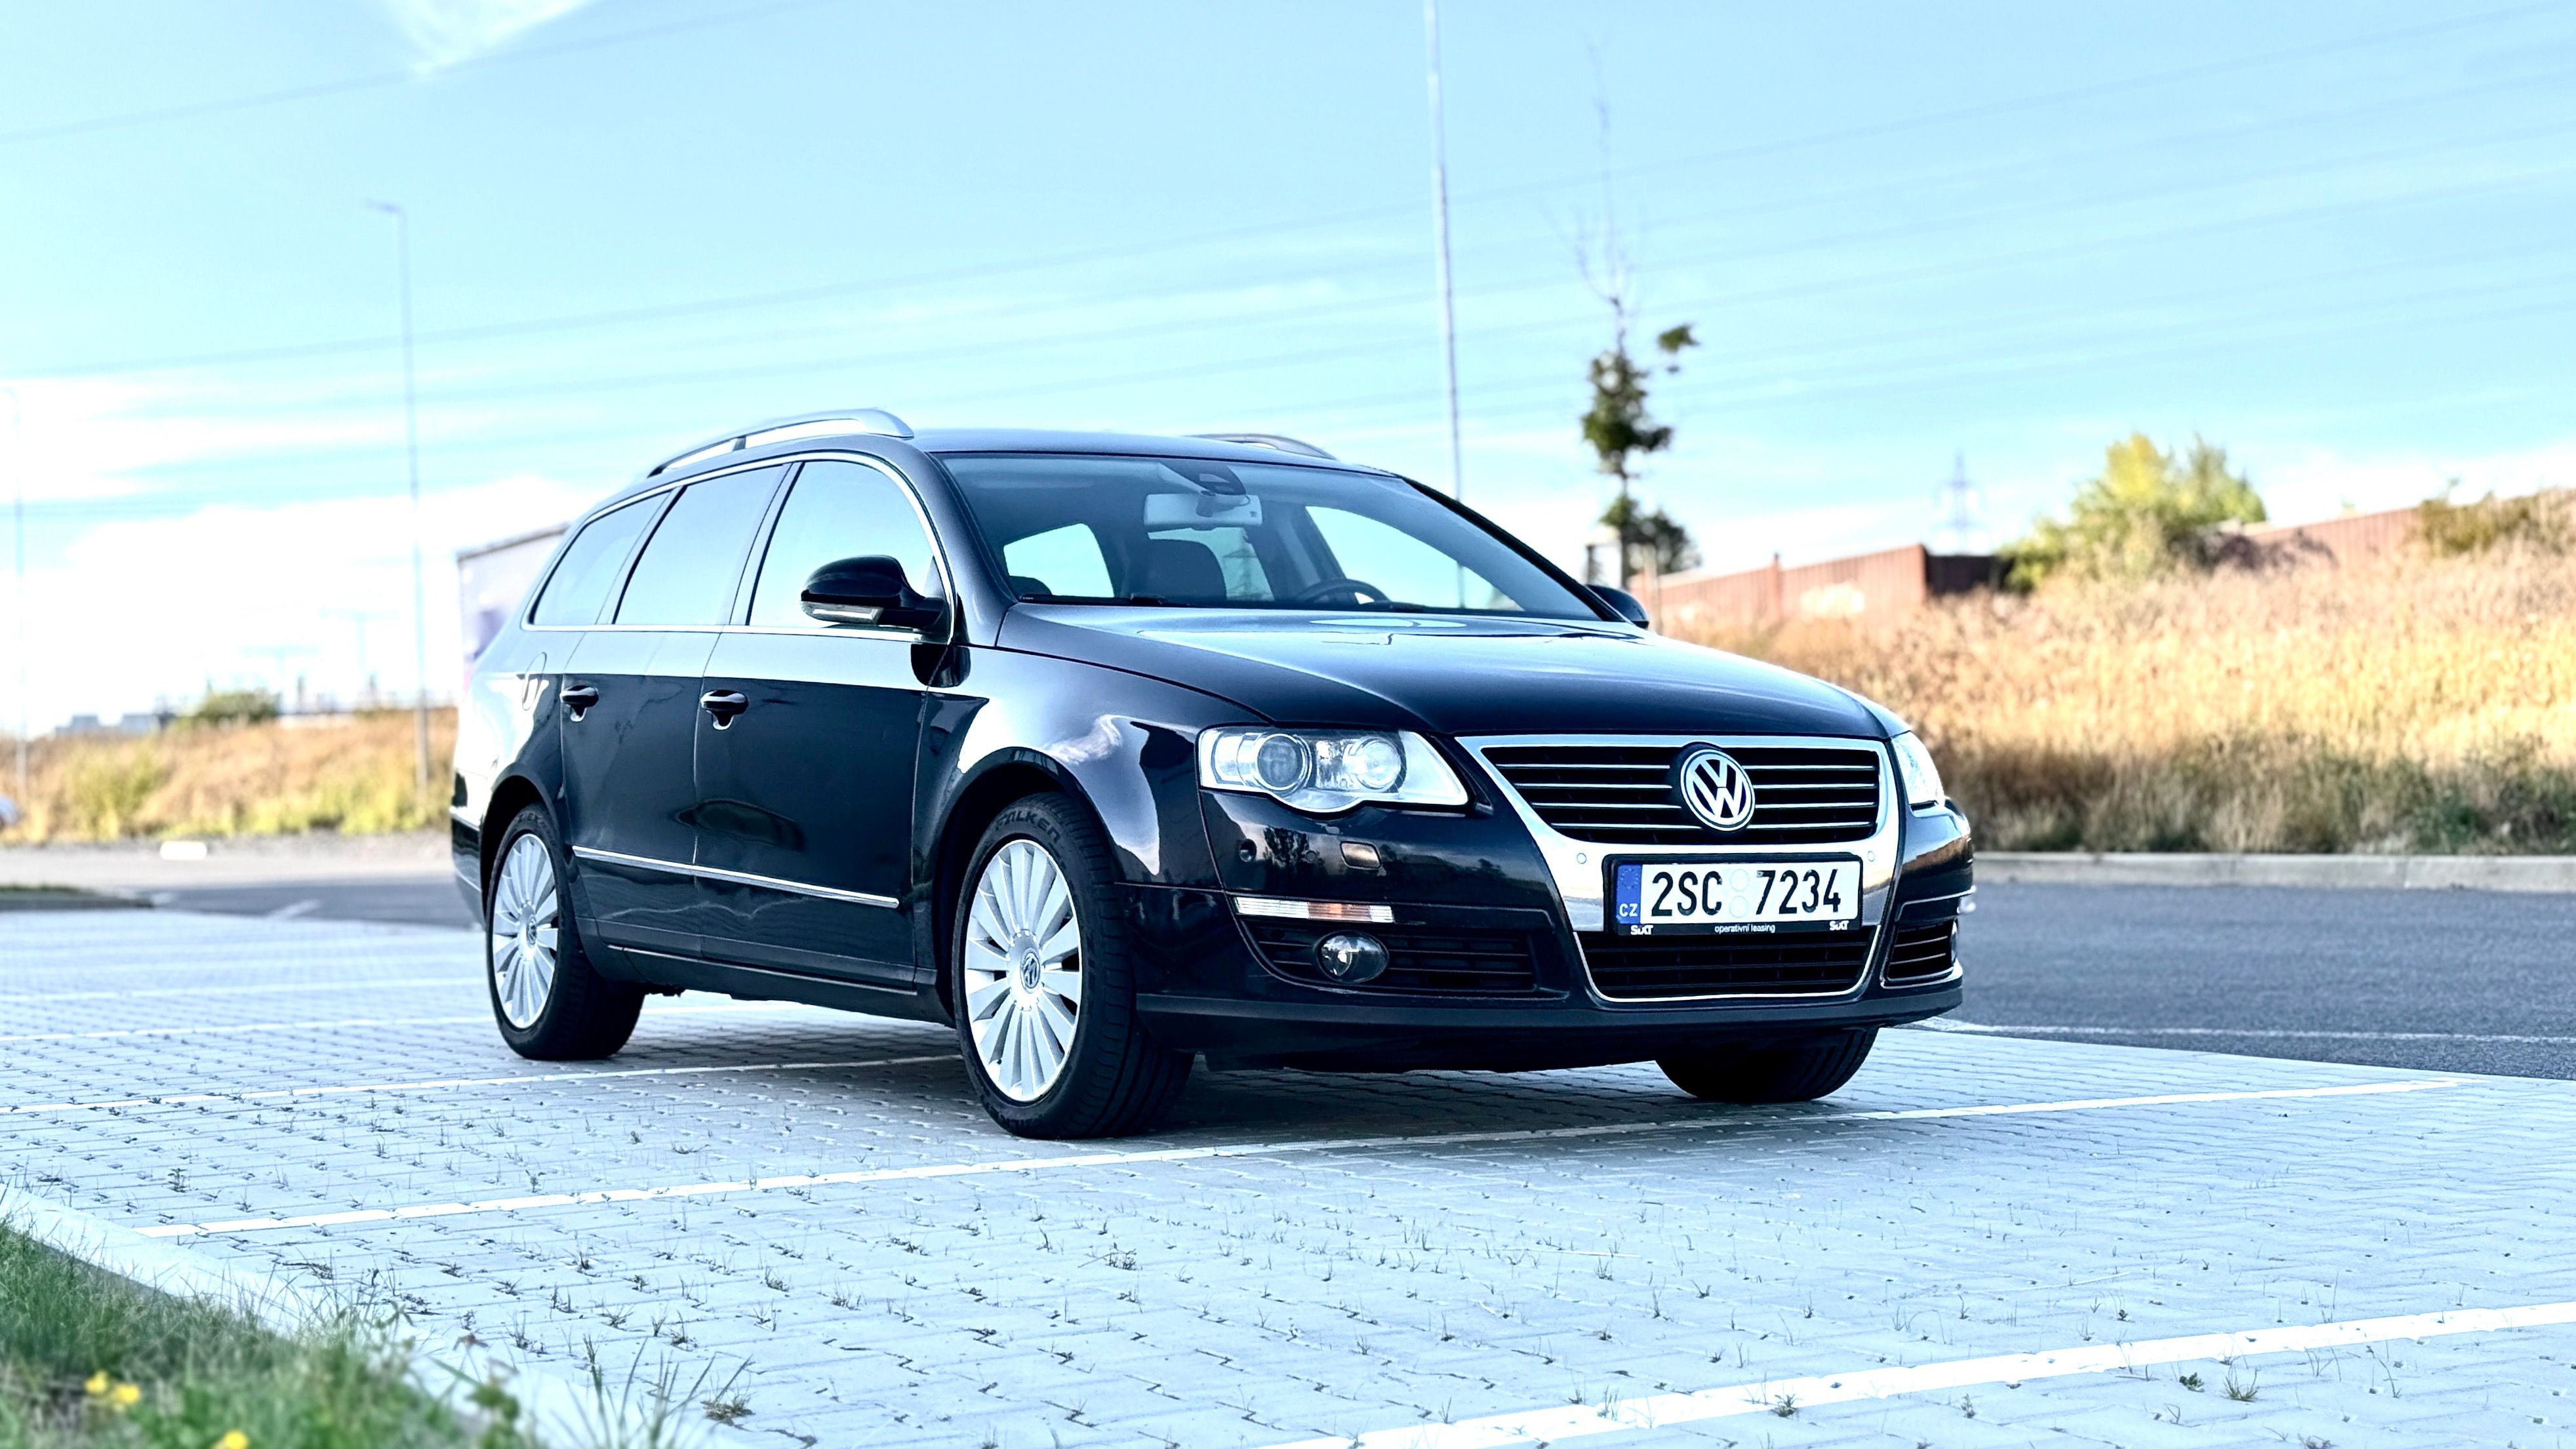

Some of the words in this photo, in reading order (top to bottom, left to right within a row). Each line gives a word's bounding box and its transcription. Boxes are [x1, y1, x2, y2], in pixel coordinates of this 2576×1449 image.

[1683, 751, 1754, 829] VW
[1651, 871, 1723, 917] 2SC
[1756, 869, 1841, 915] 7234
[1619, 903, 1638, 917] CZ
[1750, 923, 1776, 934] leasing
